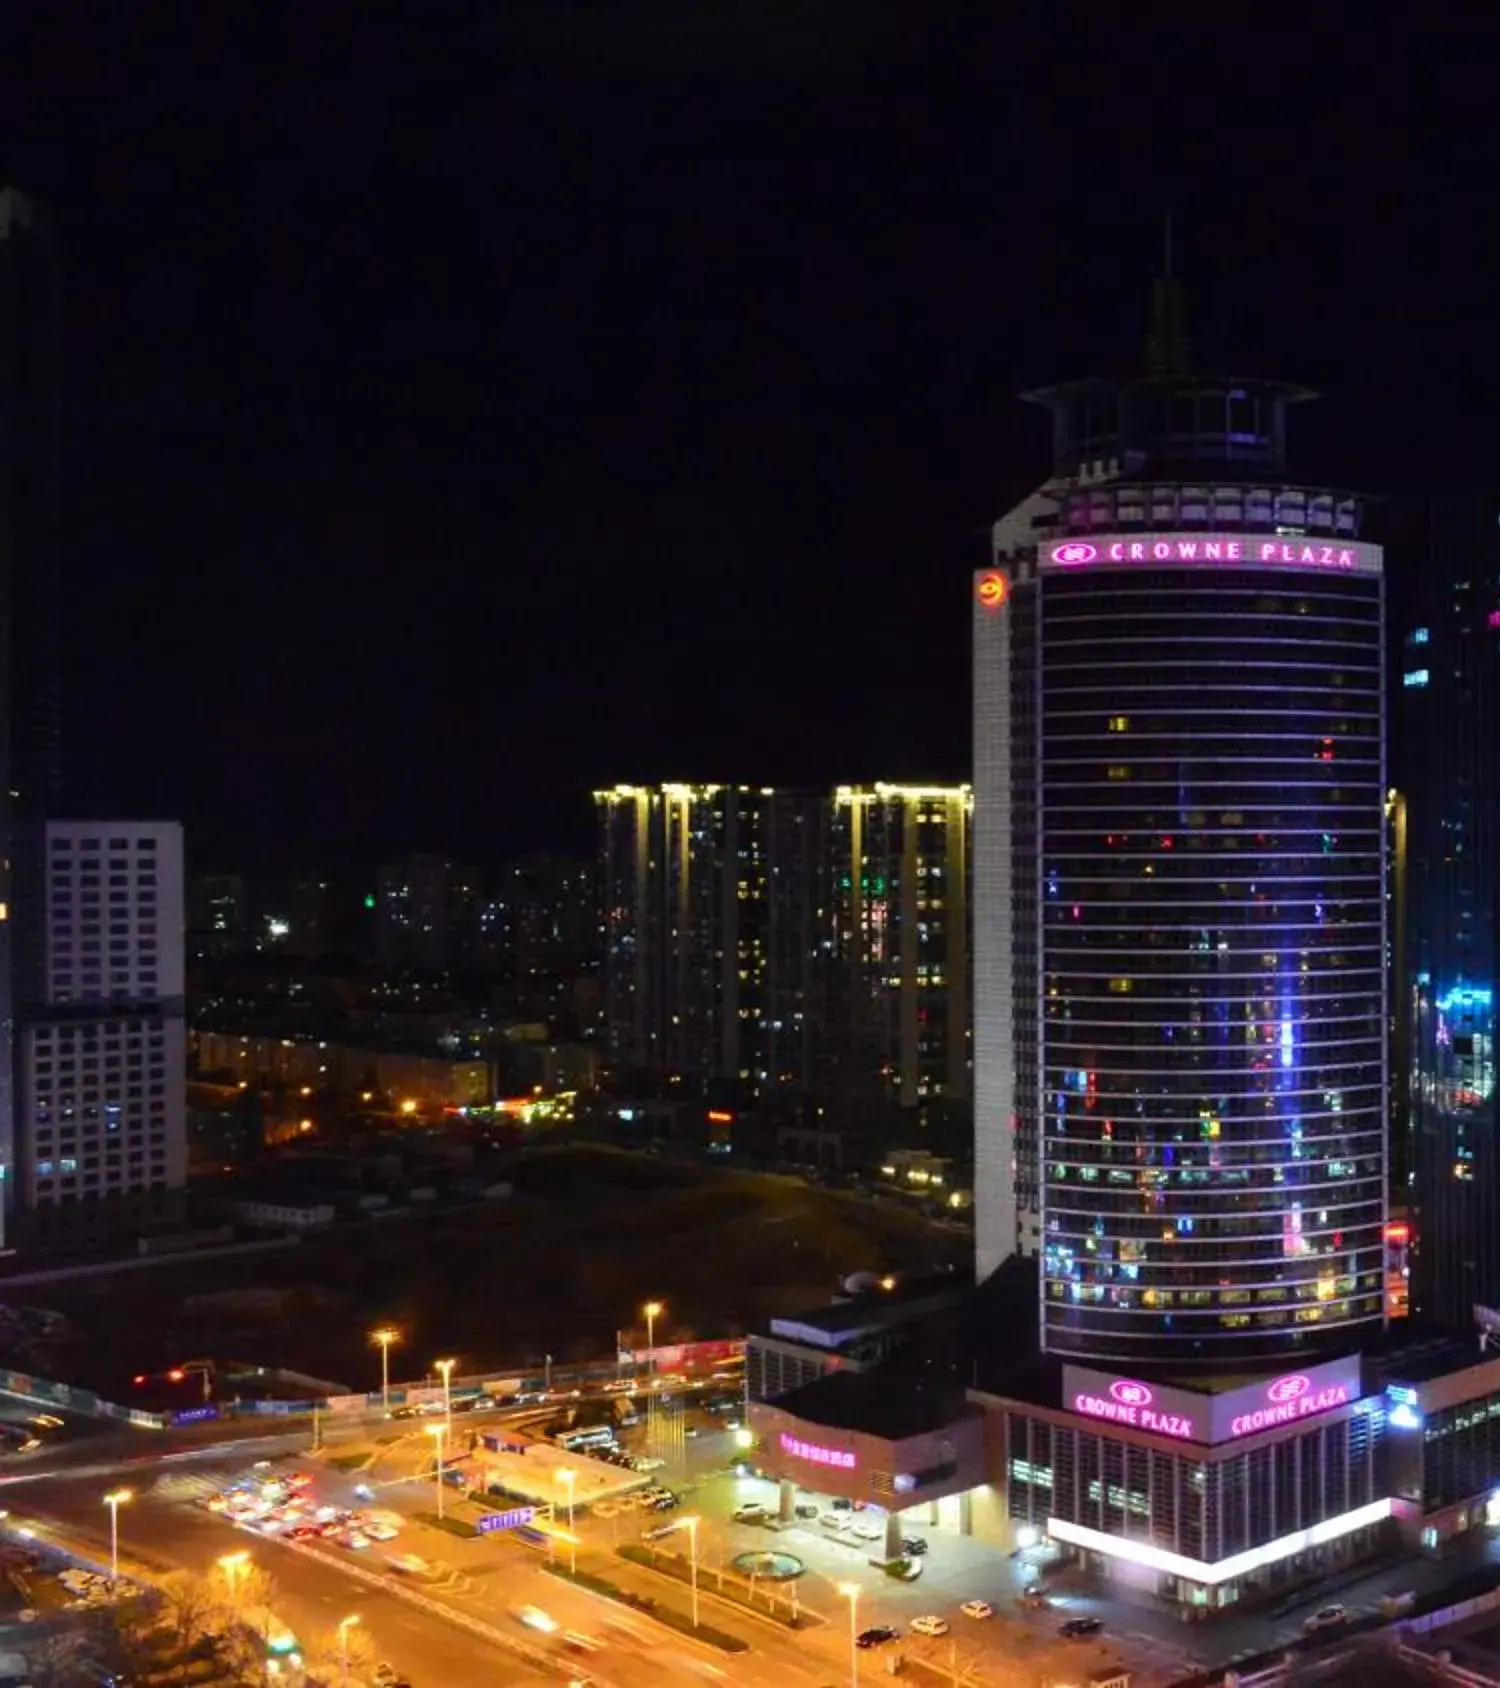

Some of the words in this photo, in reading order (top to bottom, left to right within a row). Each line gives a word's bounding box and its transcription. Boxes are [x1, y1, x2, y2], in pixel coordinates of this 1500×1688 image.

[1110, 543, 1240, 560] CROWNE
[1261, 543, 1352, 566] PLAZA
[1075, 1395, 1137, 1424] CROWNE
[1140, 1410, 1190, 1437] PLAZA
[1231, 1401, 1297, 1435] CROWNE
[1299, 1387, 1346, 1414] PLAZA
